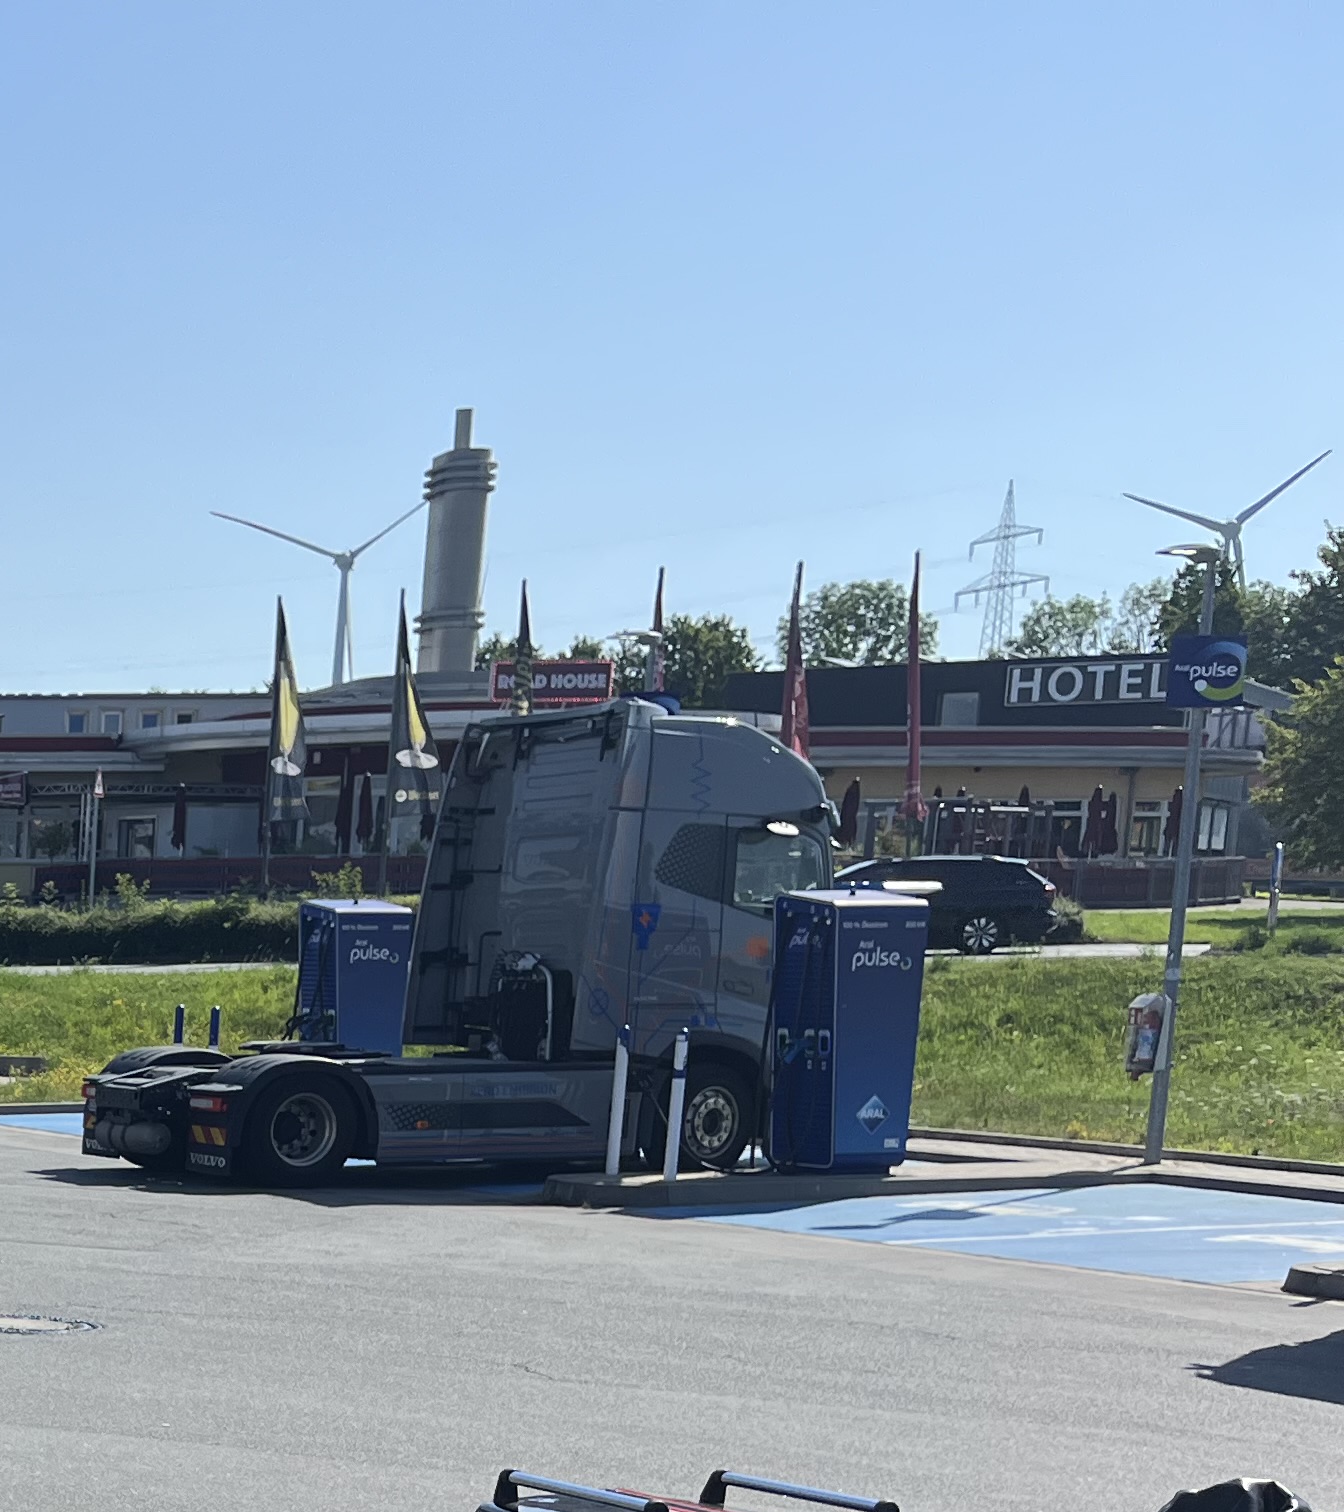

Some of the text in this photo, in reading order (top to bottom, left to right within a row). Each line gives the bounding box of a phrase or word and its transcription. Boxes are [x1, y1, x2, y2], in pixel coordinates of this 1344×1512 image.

[498, 673, 607, 689] RD HOUSE
[1189, 661, 1239, 681] pulse
[1010, 663, 1167, 703] HOTEL
[349, 944, 390, 965] pulse
[851, 946, 901, 972] pulse
[189, 1152, 226, 1168] VOLVO
